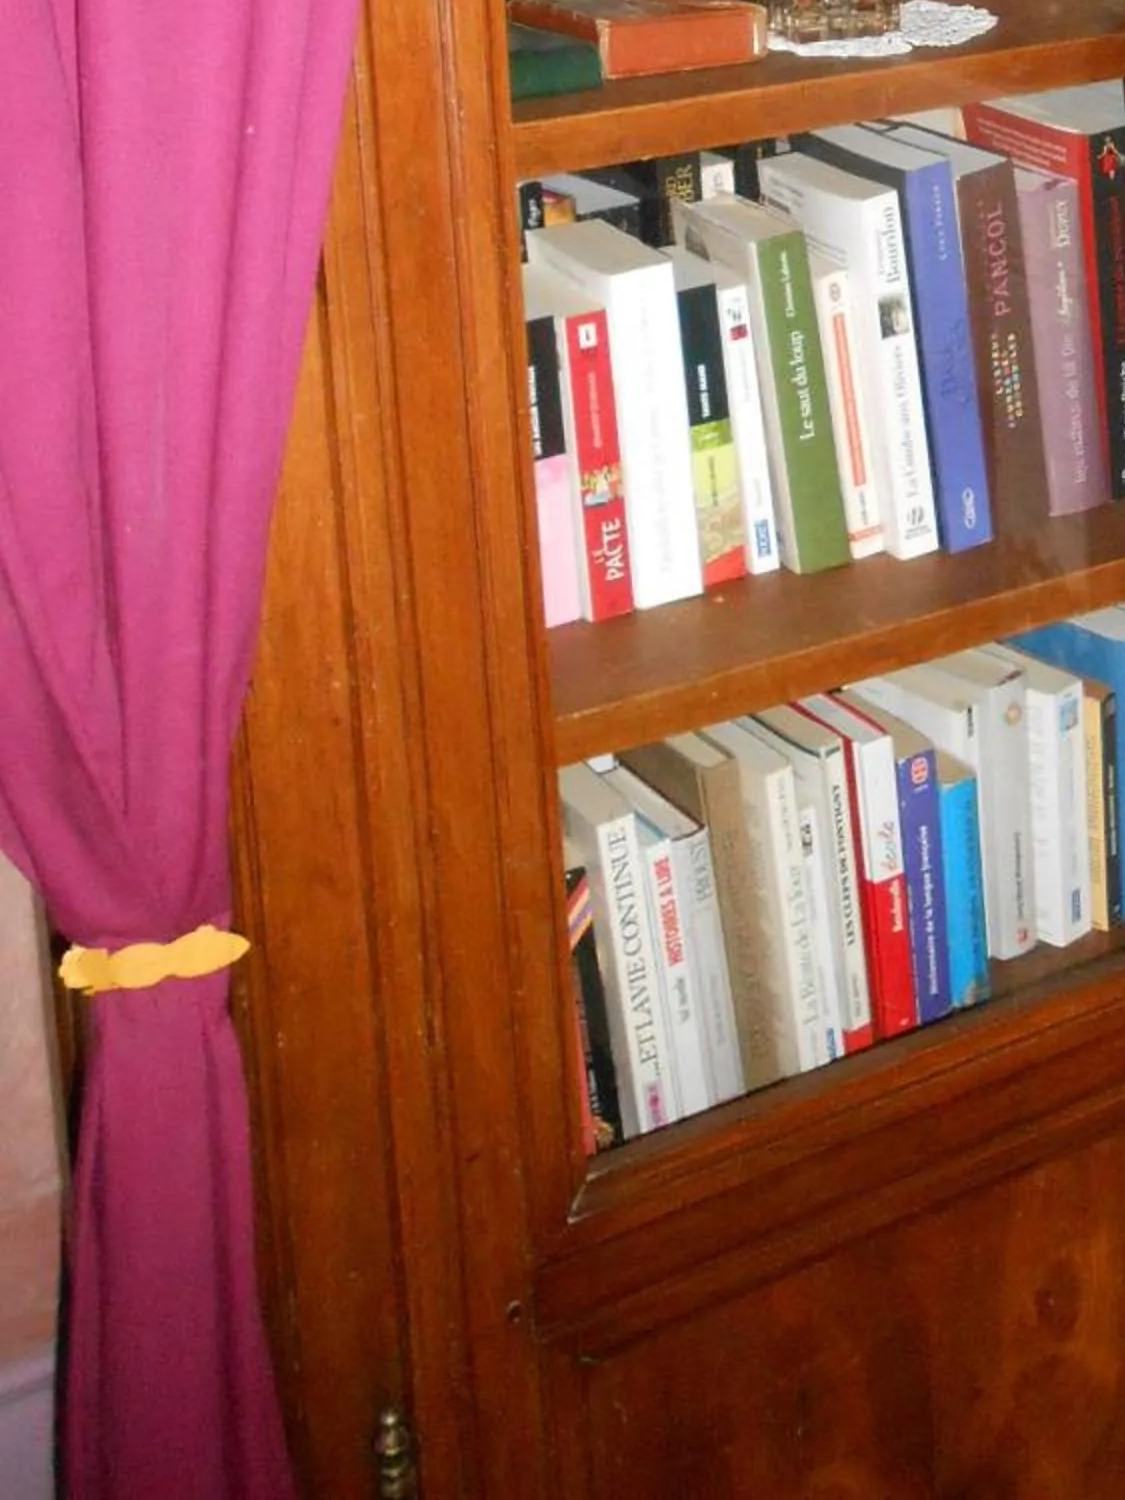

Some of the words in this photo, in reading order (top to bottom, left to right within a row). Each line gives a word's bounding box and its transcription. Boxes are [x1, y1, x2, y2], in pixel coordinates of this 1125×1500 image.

[986, 207, 1011, 318] PANCOL
[789, 330, 805, 366] loup
[791, 364, 809, 387] du
[797, 387, 813, 418] saut
[799, 419, 816, 441] Le
[603, 516, 625, 582] PACTE
[607, 828, 643, 958] CONTINUE
